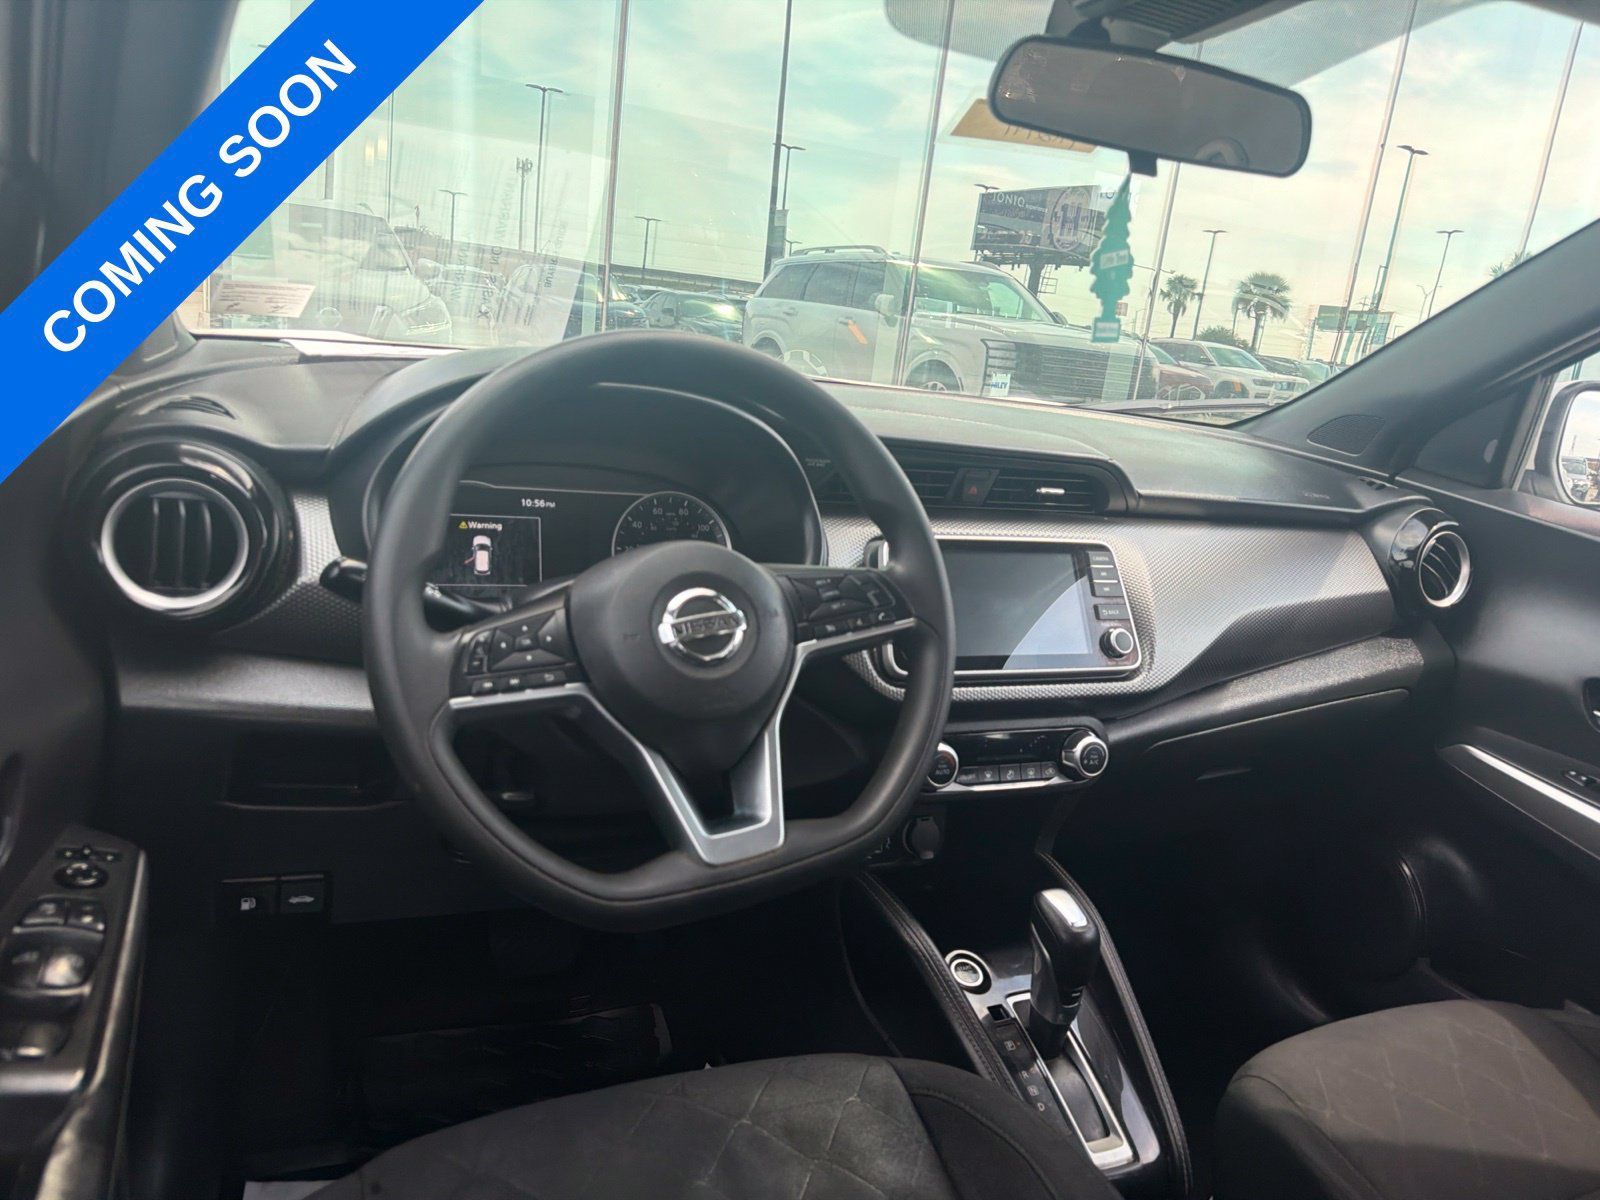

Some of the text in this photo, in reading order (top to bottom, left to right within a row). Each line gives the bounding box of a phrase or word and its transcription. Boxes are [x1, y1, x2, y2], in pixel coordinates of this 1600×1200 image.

[521, 498, 545, 508] 10:56
[652, 507, 663, 515] 60
[678, 508, 689, 516] 80
[467, 521, 503, 531] Warning
[632, 521, 643, 529] 40
[673, 617, 738, 639] NISSAN
[1037, 1102, 1046, 1112] D
